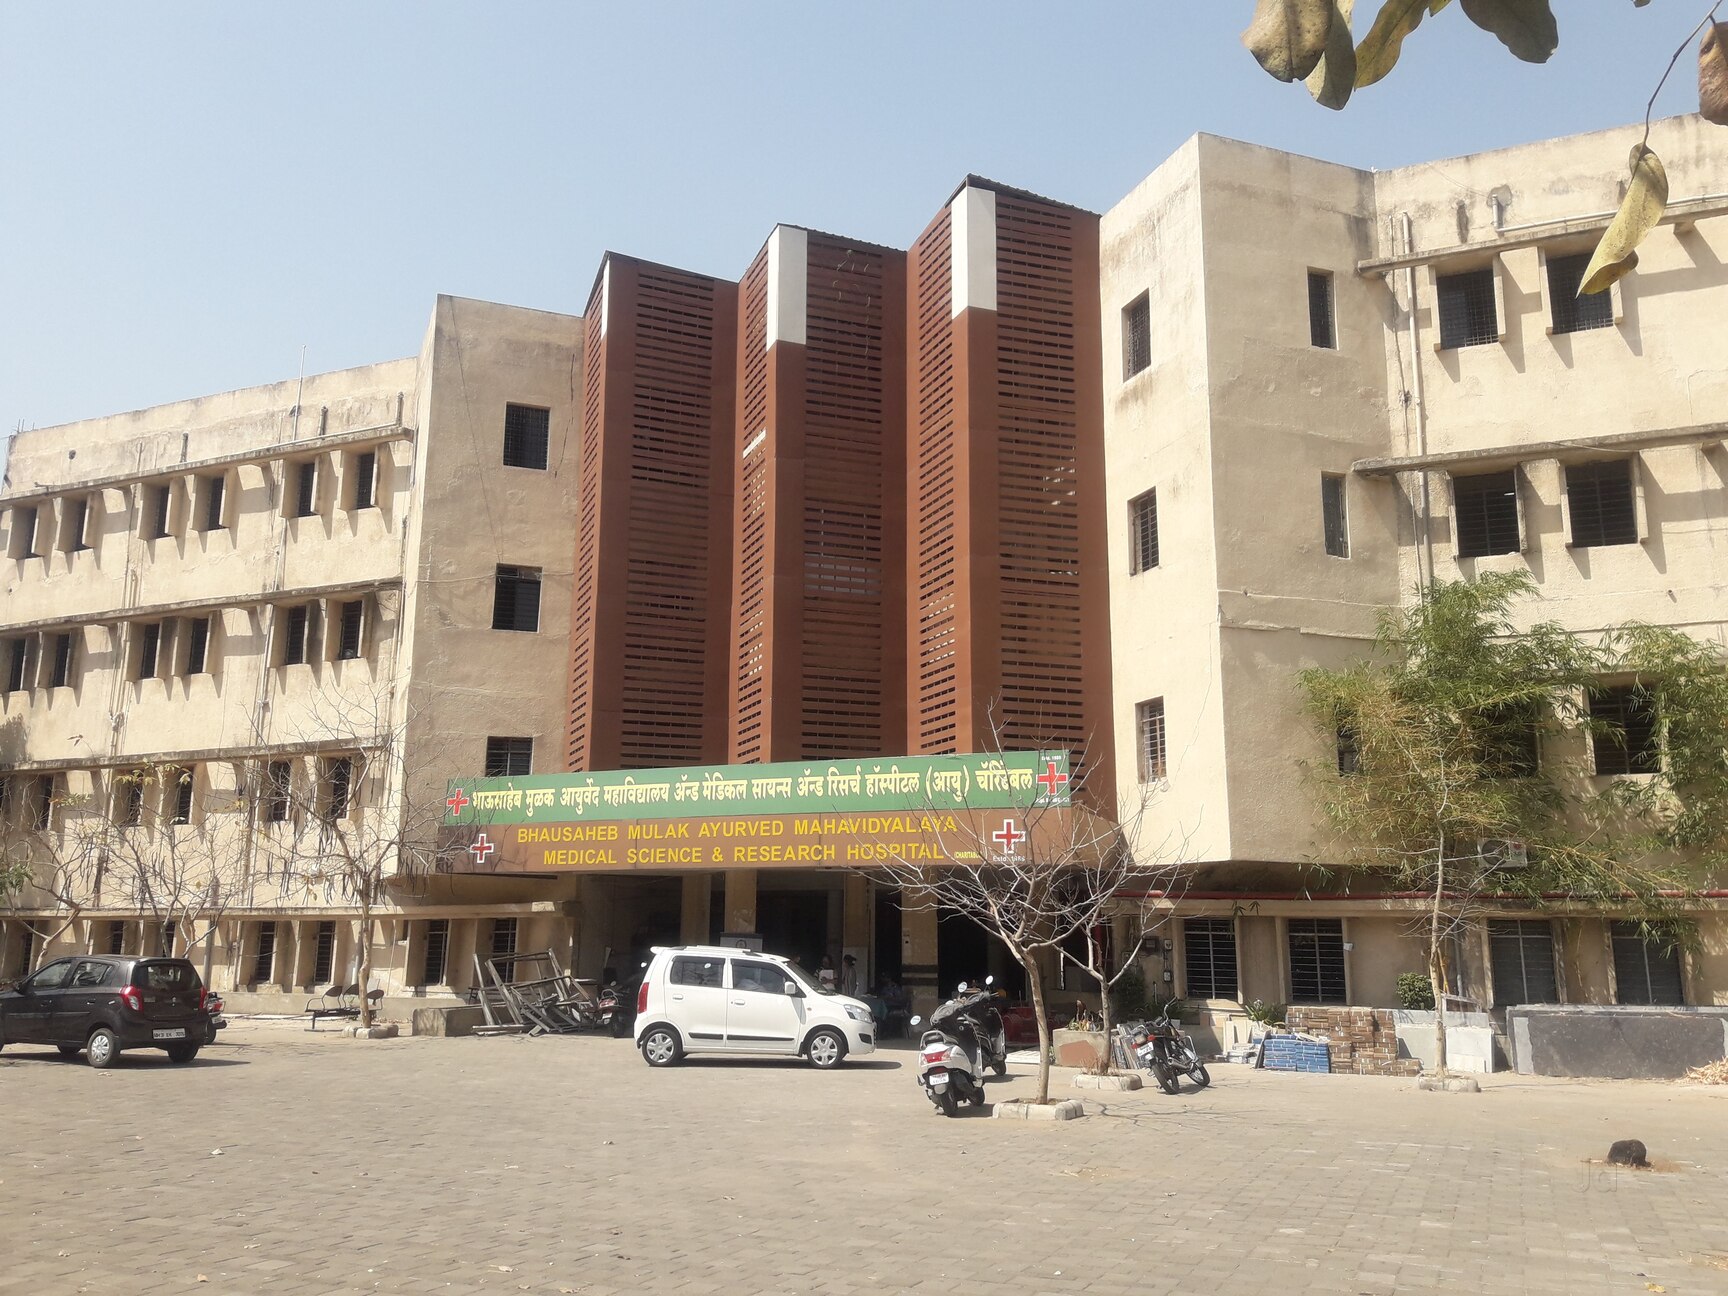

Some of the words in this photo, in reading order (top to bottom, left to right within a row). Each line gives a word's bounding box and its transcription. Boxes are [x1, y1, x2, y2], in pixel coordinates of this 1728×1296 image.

[525, 788, 556, 817] मुळक
[560, 777, 600, 815] आयुर्वेद
[603, 776, 670, 807] महाविद्यालय
[702, 771, 748, 800] मेडिकल
[751, 777, 792, 799] सायन्स
[827, 766, 861, 797] रिसर्च
[864, 764, 921, 798] हॉस्पीटल
[925, 765, 970, 802] (आयु)
[517, 825, 619, 843] BHAUSAHEB
[628, 822, 690, 840] MULAK
[698, 820, 784, 838] AYURVED
[794, 815, 958, 835] MAHAVIDYALAYA
[543, 849, 618, 865] MEDICAL
[626, 847, 702, 864] SCIENCE
[711, 846, 724, 862] &
[733, 844, 836, 862] RESEARCH
[847, 842, 945, 861] HOSPITAL
